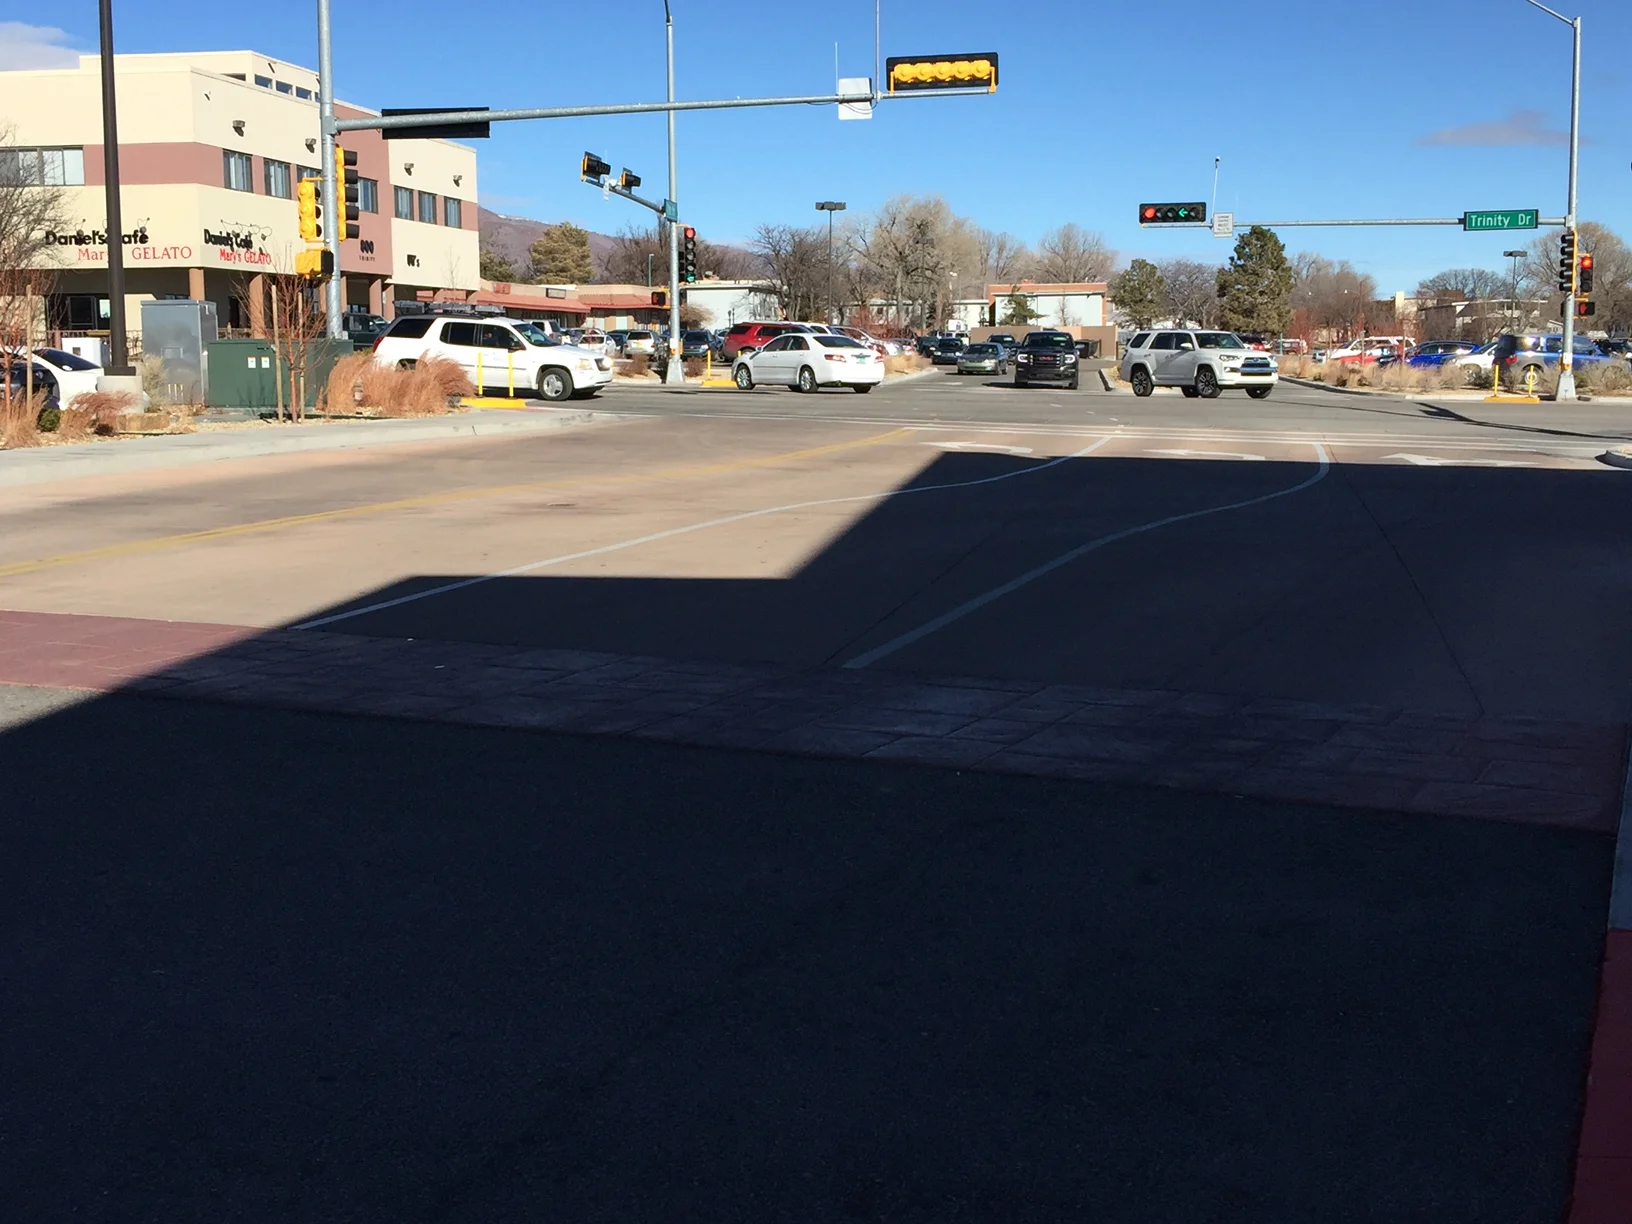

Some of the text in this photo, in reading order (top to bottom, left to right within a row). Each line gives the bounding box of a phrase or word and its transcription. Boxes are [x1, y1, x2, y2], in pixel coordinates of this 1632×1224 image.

[1470, 213, 1532, 228] Trinity Dr
[44, 230, 107, 246] Danel's
[131, 246, 192, 259] GELATO
[244, 249, 272, 265] GELATO
